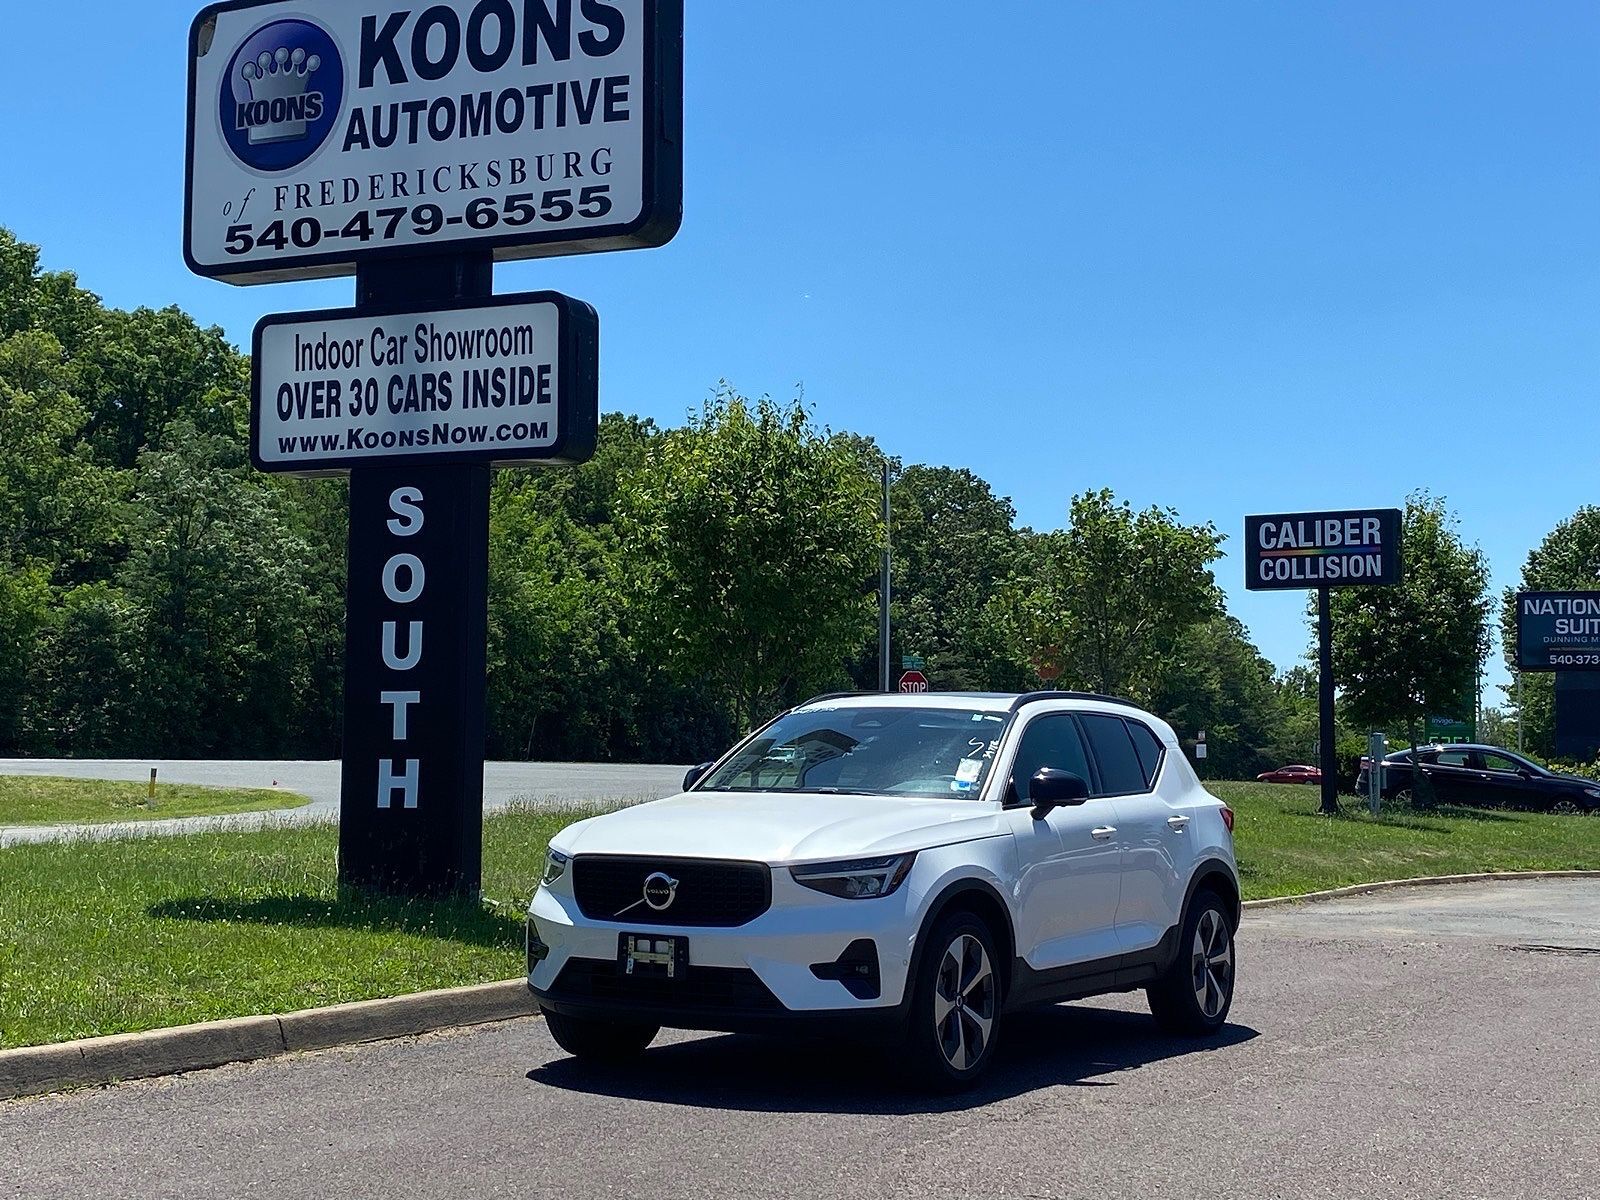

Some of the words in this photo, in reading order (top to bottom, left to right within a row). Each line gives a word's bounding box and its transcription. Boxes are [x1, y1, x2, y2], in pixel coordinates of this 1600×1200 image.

[358, 0, 625, 88] KOONS
[237, 91, 323, 129] KOONS
[342, 75, 630, 152] AUTOMOTIVE
[222, 188, 256, 223] of
[273, 148, 613, 211] FREDERICKSBURG
[224, 185, 613, 254] 540-479-6555
[294, 331, 364, 372] Indoor
[370, 326, 408, 366] Car
[414, 323, 533, 364] Showroom
[276, 380, 342, 422] OVER
[350, 377, 379, 416] 30
[387, 371, 453, 415] CARS
[462, 364, 552, 409] INSIDE
[1258, 517, 1382, 550] CALIBER
[1259, 554, 1382, 581] COLLISION
[1524, 598, 1600, 615] NATION
[1555, 618, 1600, 635] SUIT
[376, 486, 426, 808] SOUTH
[901, 681, 926, 693] STOP
